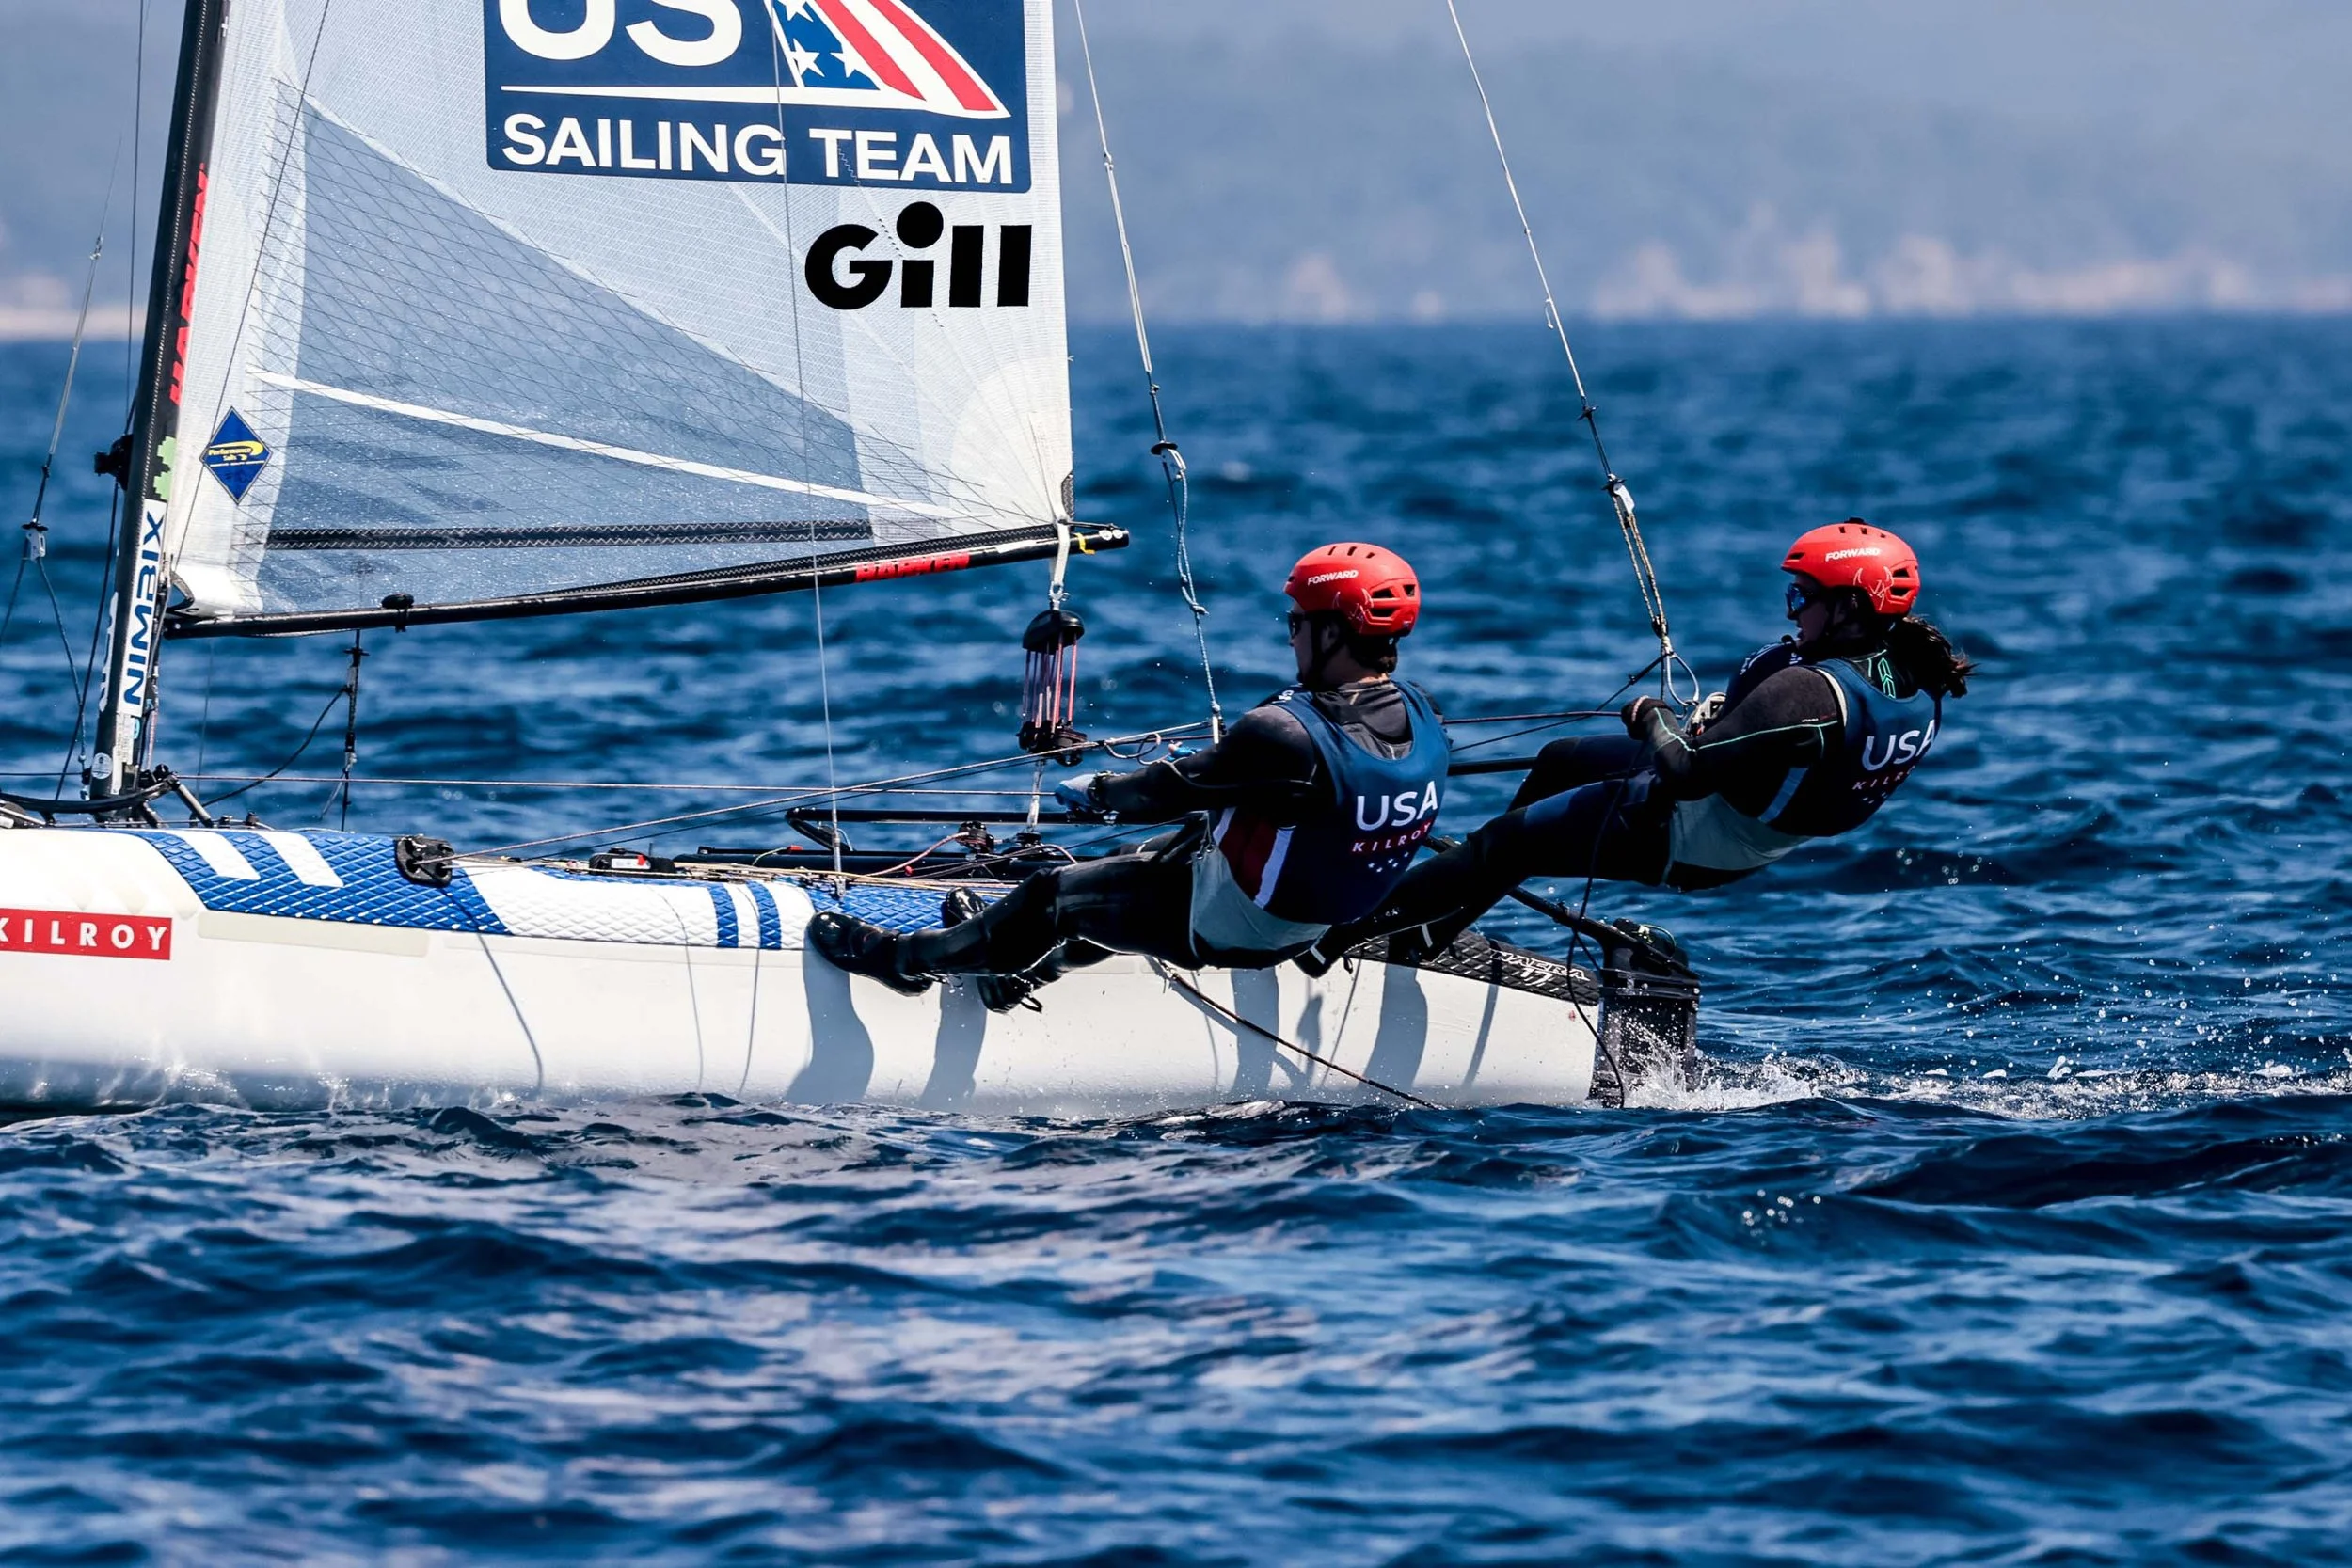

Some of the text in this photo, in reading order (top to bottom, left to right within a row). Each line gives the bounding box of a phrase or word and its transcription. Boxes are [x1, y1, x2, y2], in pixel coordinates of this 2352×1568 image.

[500, 0, 743, 67] US
[501, 113, 1013, 185] SAILING TEAM
[804, 200, 1033, 311] Gill
[1307, 569, 1359, 586] FORWARD
[1825, 547, 1881, 562] FORWARD
[123, 510, 165, 706] NIMBIX
[1861, 719, 1936, 771] USA
[1356, 780, 1438, 832] USA
[1351, 821, 1431, 852] KILROY
[1520, 967, 1553, 987] 17
